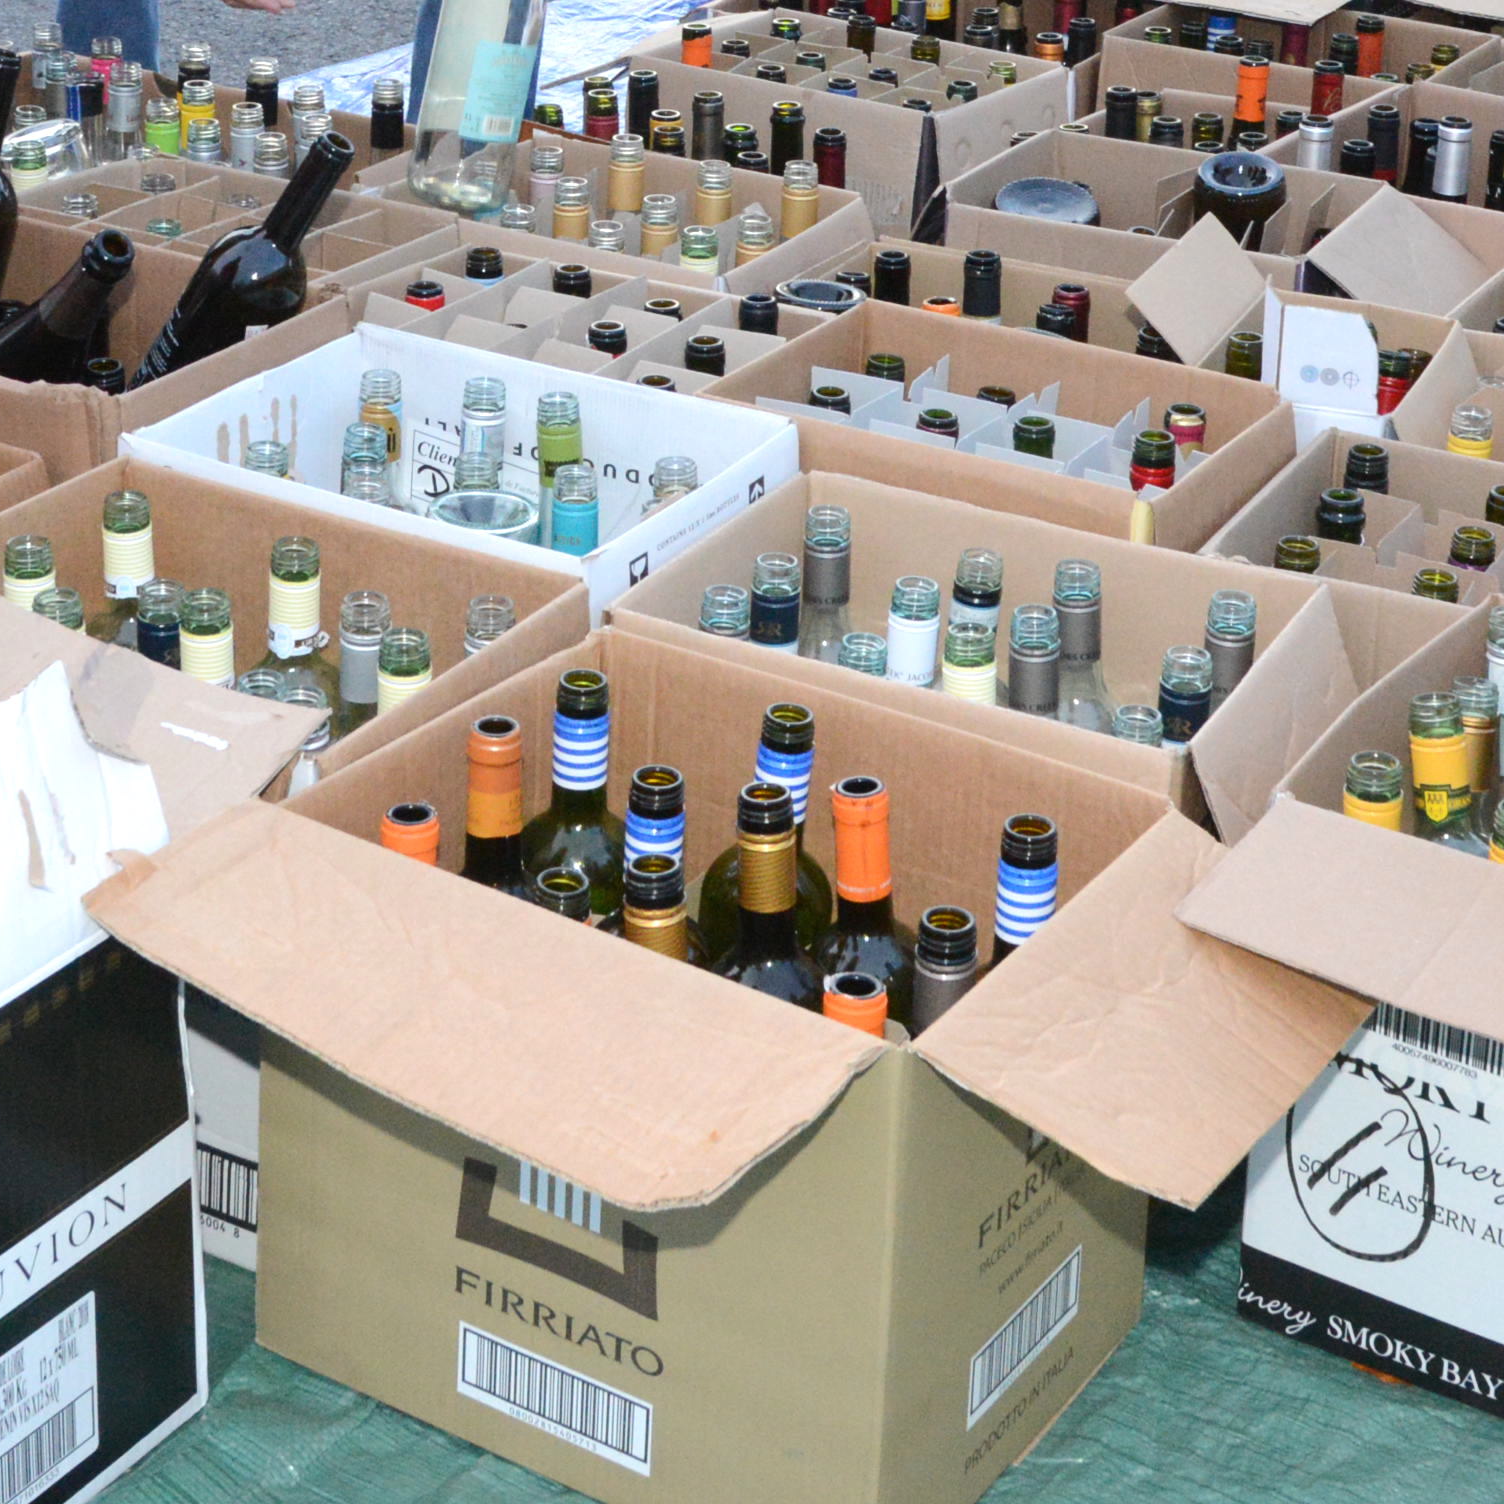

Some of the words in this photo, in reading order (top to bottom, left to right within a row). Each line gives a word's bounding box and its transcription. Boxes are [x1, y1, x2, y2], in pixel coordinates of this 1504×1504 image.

[416, 439, 458, 467] Clien
[1298, 1153, 1372, 1198] SOUTH
[1376, 1182, 1477, 1236] EASTERN
[454, 1264, 665, 1377] FIRRIATO
[1237, 1265, 1317, 1335] inery
[1327, 1314, 1436, 1374] SMOKY
[963, 1396, 1027, 1476] PRODOTTO
[1028, 1379, 1041, 1403] IN
[1041, 1347, 1075, 1389] ITALIA
